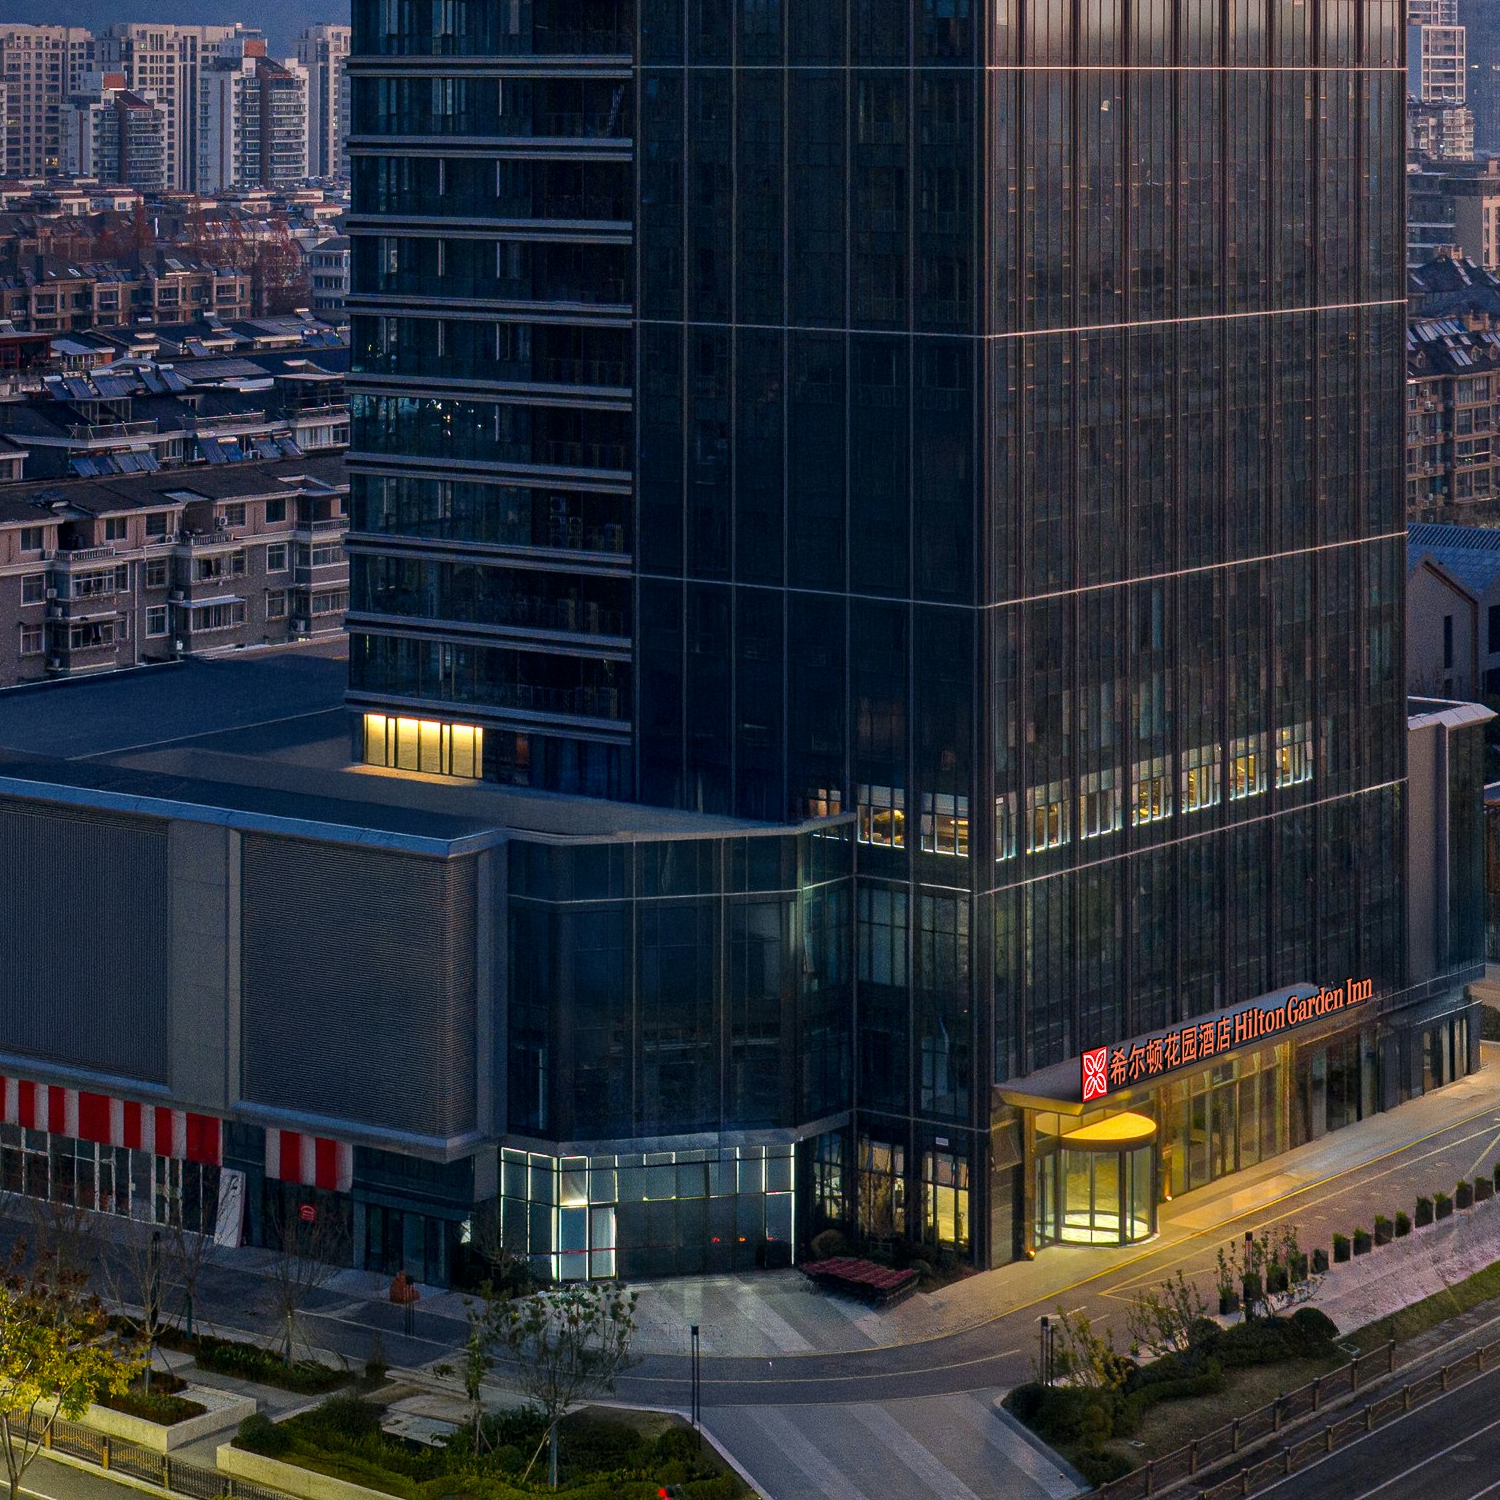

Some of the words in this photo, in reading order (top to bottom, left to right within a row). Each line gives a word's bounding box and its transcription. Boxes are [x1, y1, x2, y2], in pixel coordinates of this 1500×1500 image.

[1234, 1006, 1286, 1044] Hilton
[1287, 985, 1344, 1026] Garden
[1346, 977, 1373, 1005] Inn
[1109, 1016, 1232, 1086] 希尔顿花园酒店
